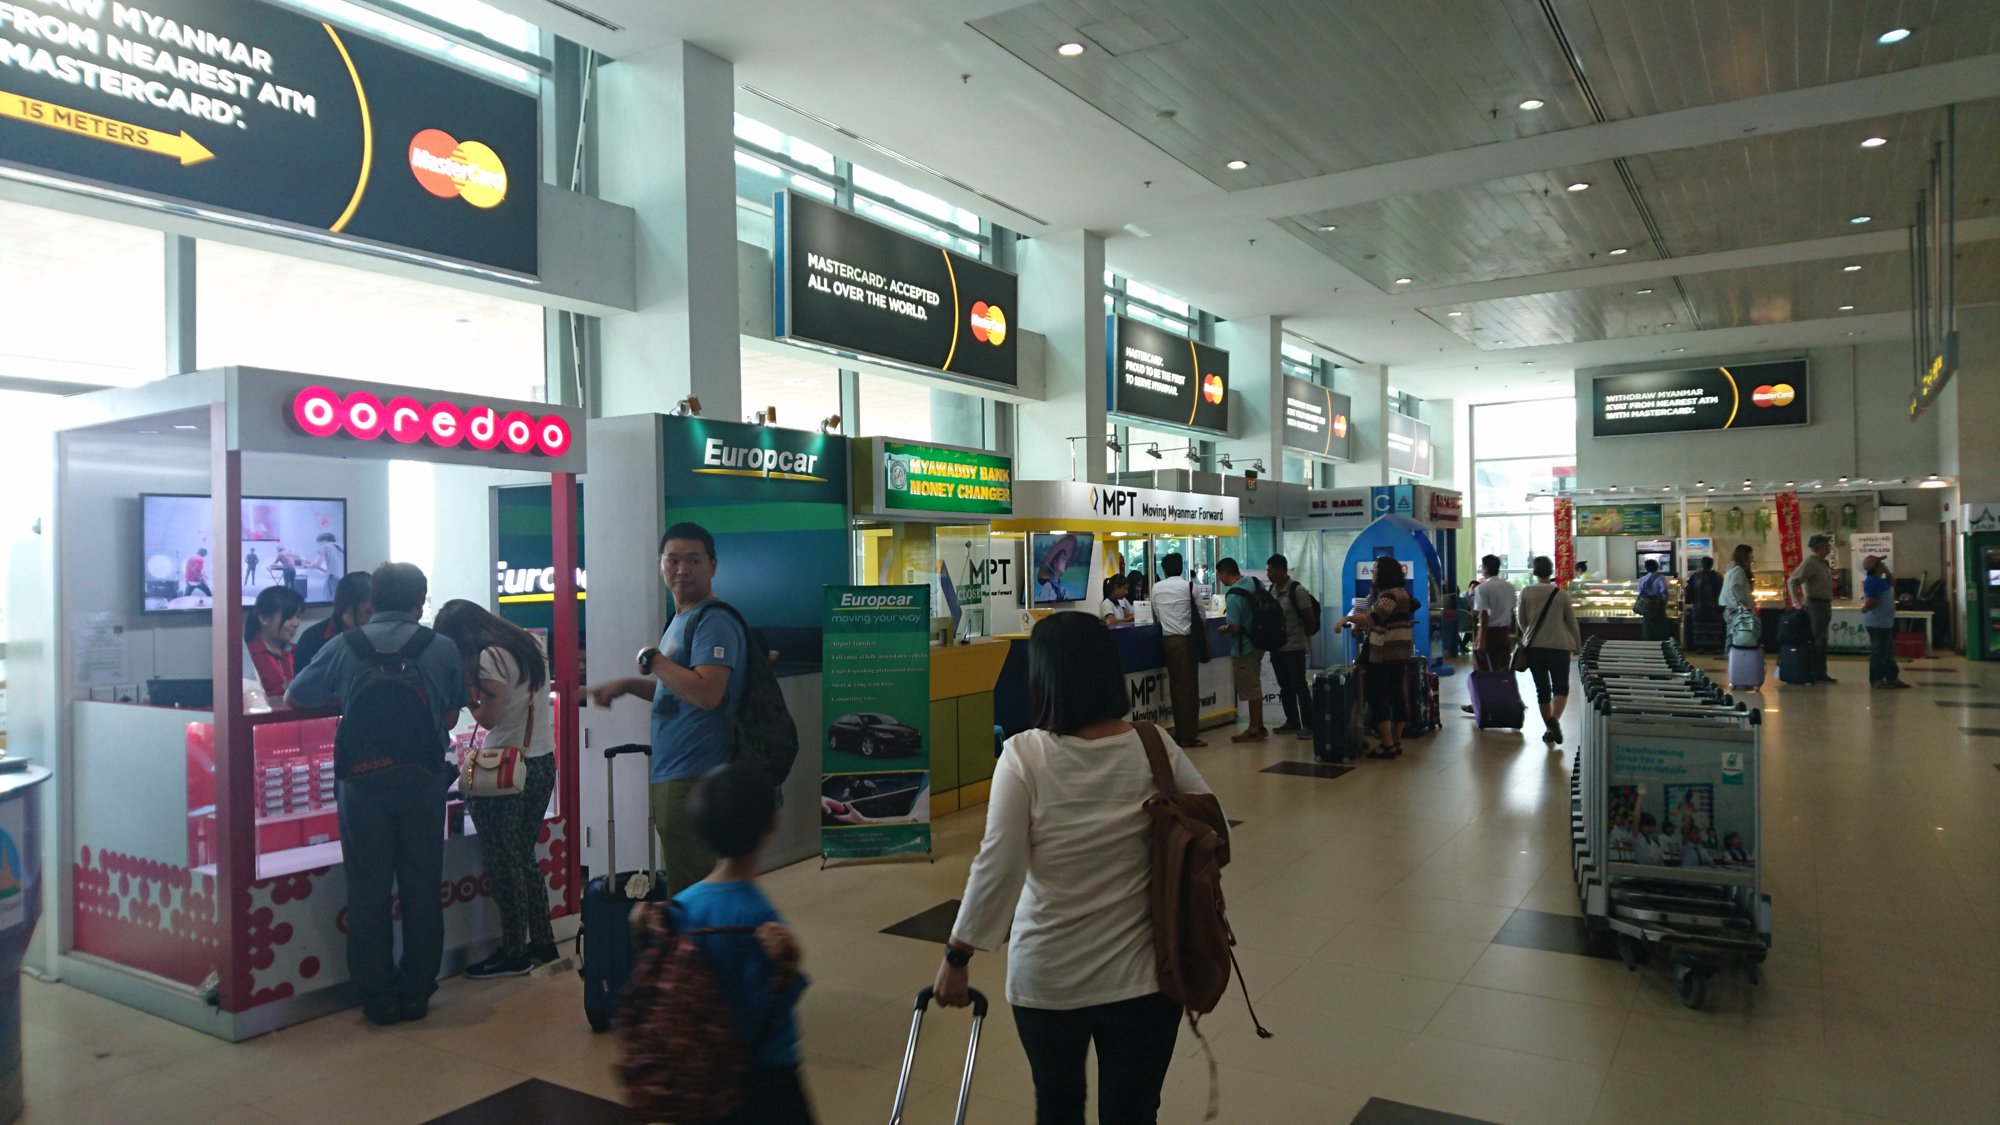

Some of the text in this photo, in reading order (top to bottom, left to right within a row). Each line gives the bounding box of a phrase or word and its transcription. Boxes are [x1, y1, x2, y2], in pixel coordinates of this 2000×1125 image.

[112, 1, 273, 74] MYANMAR
[0, 2, 99, 54] FROM
[106, 34, 255, 99] NEAREST
[257, 82, 316, 117] ATM
[19, 100, 149, 146] 15 METERS
[808, 274, 927, 320] ALL OVER THE WORLD.
[889, 279, 940, 306] ACCEPTED
[1125, 360, 1145, 374] PROUD
[1146, 365, 1154, 376] TO
[1162, 370, 1172, 382] THE
[1125, 373, 1134, 385] TO
[1605, 388, 1704, 402] WITHDRAW MYANMAR
[1605, 396, 1719, 411] KYAT FROM NEAREST ATM
[304, 397, 563, 448] ooredoo
[1605, 410, 1630, 420] WITH
[703, 438, 818, 477] Europcar
[909, 458, 1010, 482] MYAWADDY BANK
[909, 480, 1011, 502] MONEY CHANGER
[1103, 488, 1223, 522] MPT Moving Myanmar Forward
[1331, 499, 1364, 508] BANK
[969, 558, 1011, 586] MPT
[840, 593, 914, 609] Europcar
[831, 614, 921, 624] moving your way
[1131, 673, 1167, 708] MPT
[352, 758, 394, 774] adidas
